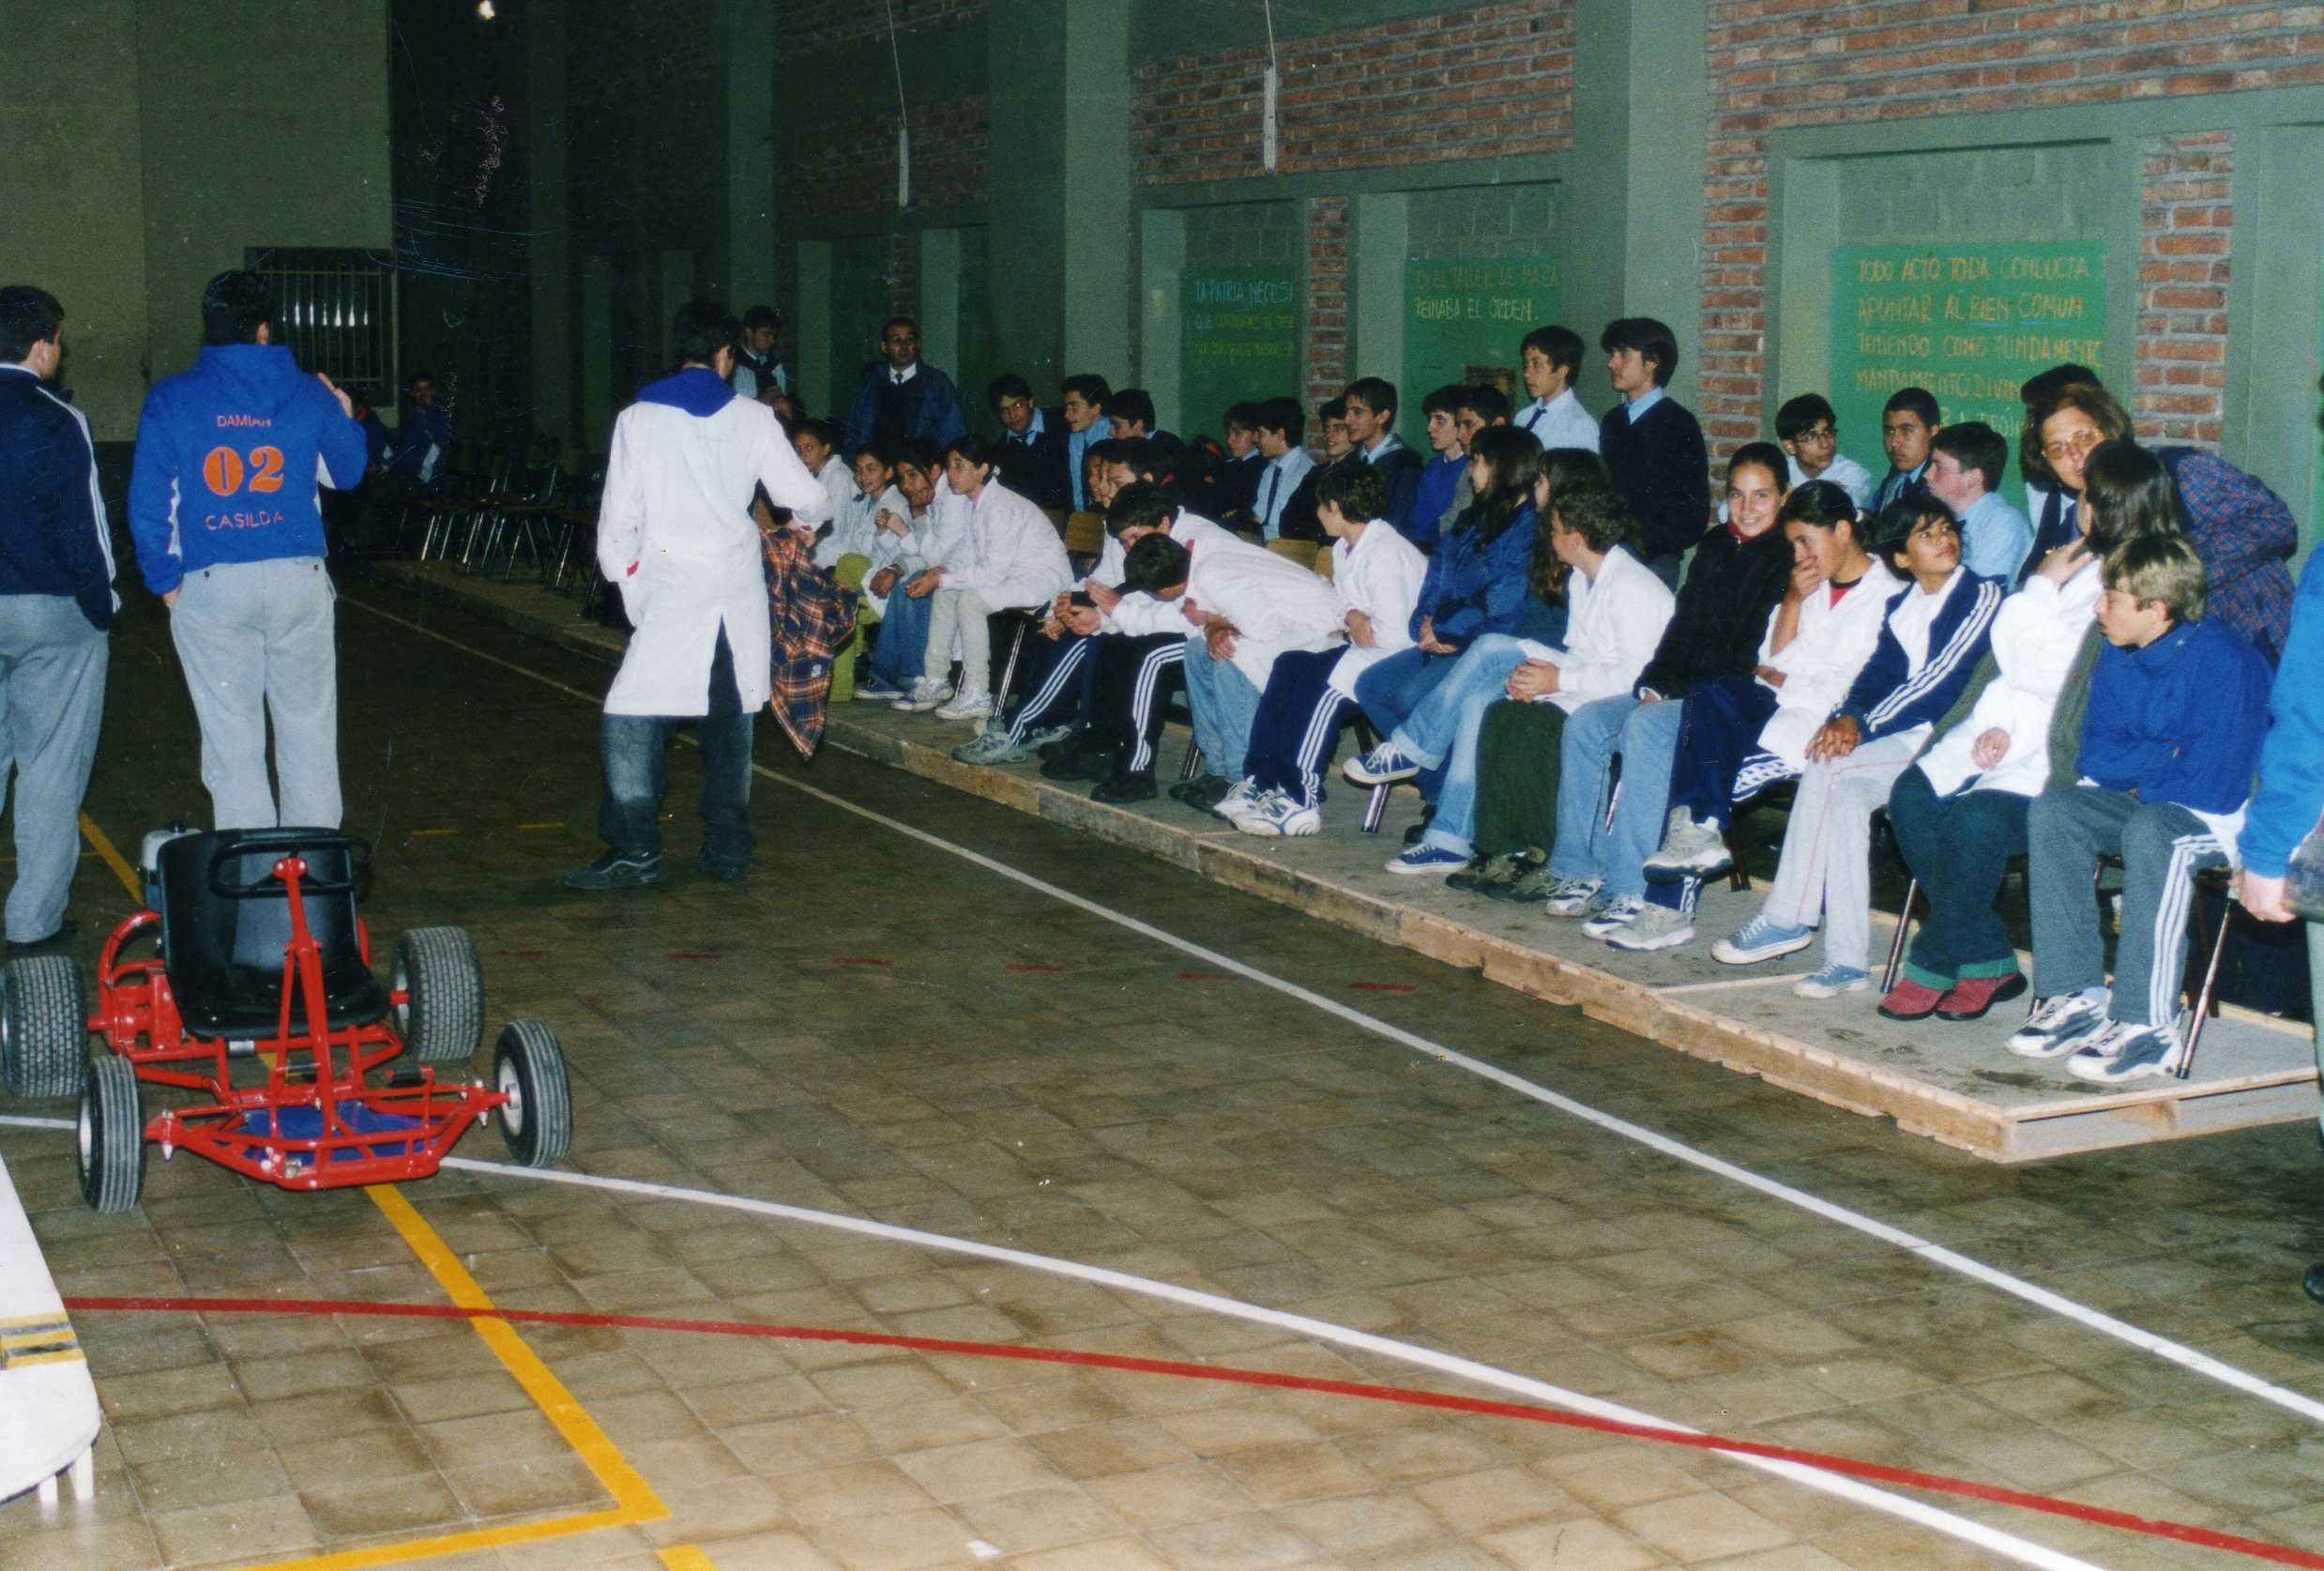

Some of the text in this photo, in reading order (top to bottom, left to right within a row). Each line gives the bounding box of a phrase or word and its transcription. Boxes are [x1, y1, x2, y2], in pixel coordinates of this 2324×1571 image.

[1901, 257, 1940, 282] ACTO
[1999, 254, 2089, 282] CONDUCTA
[1249, 280, 1293, 307] NECESI
[1945, 293, 1967, 320] AL
[1466, 297, 1482, 319] EL
[1974, 373, 2022, 401] DIVIN
[203, 446, 285, 496] 02
[205, 511, 284, 531] CASILDA
